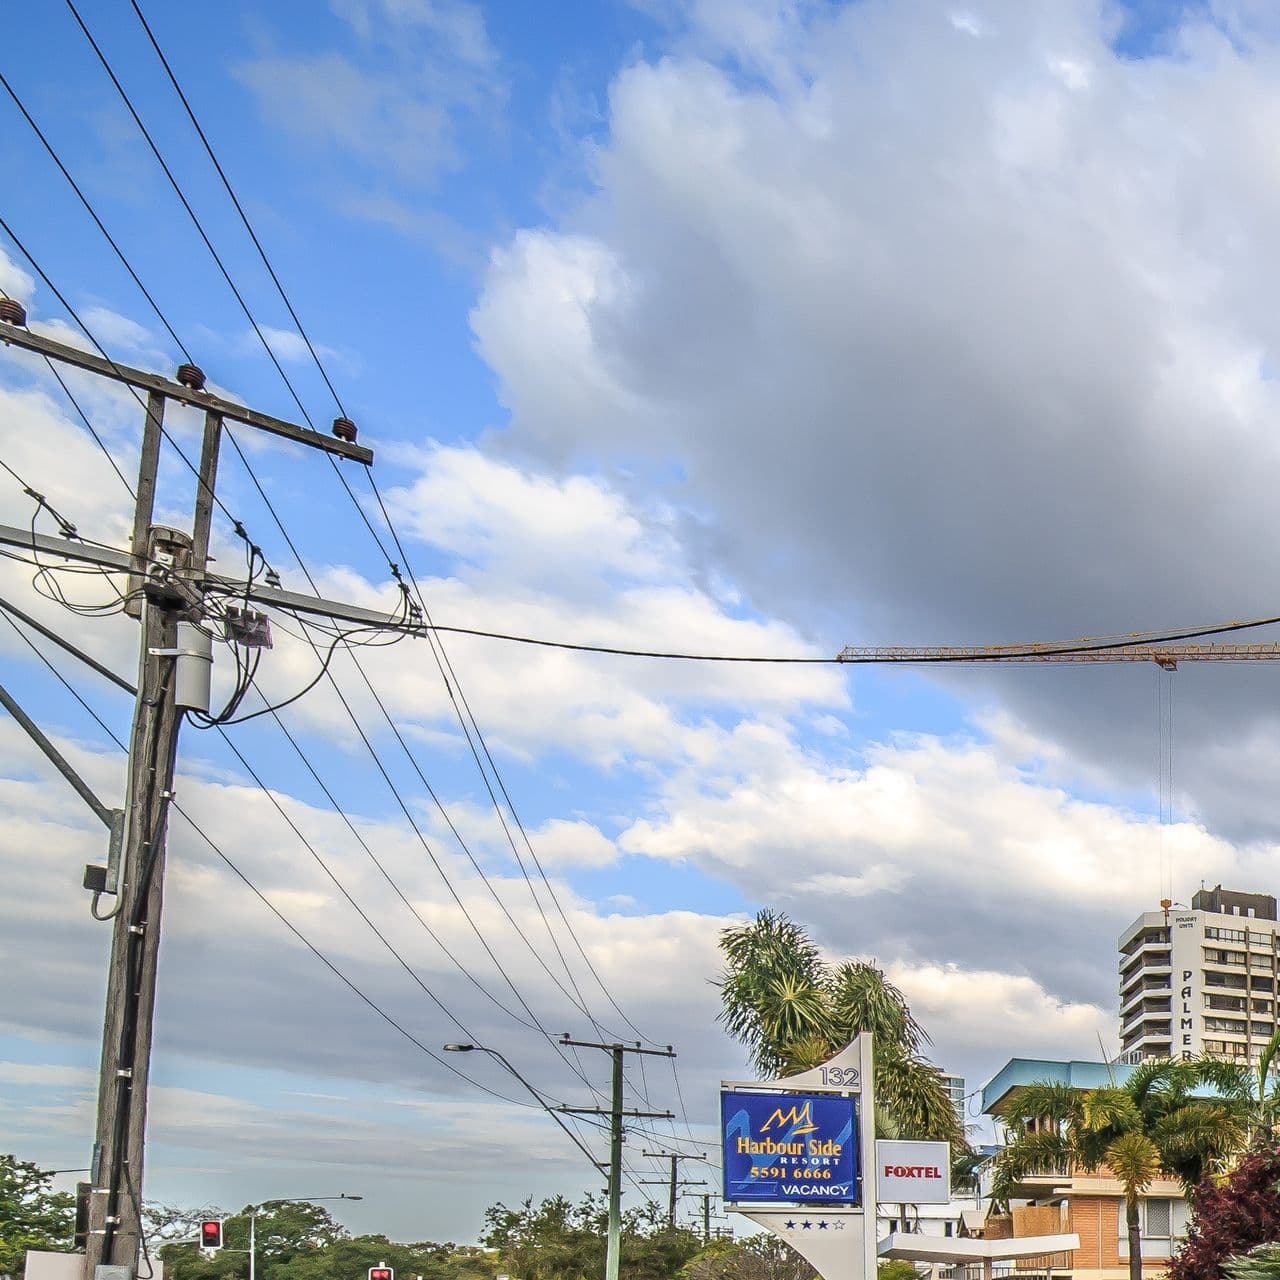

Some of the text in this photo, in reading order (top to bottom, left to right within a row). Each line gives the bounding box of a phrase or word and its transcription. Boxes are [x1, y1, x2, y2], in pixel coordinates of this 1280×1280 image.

[1180, 970, 1193, 1061] PALMER
[819, 1066, 860, 1087] 132
[737, 1137, 842, 1157] Harbour Side
[780, 1157, 841, 1166] RESORT
[750, 1166, 832, 1180] 5591 6666
[884, 1165, 942, 1179] FOXTEL
[781, 1184, 849, 1196] VACANCY
